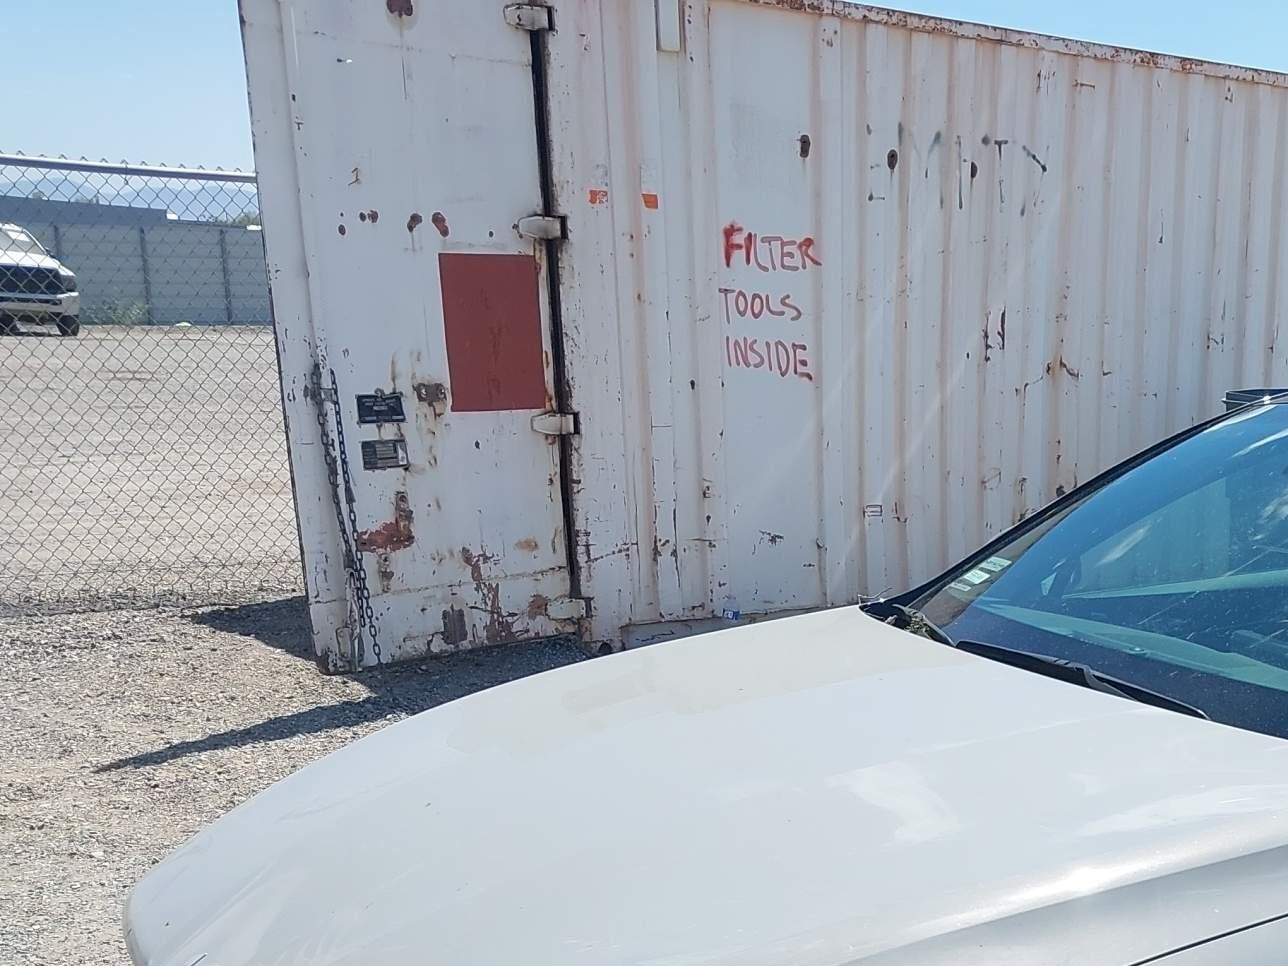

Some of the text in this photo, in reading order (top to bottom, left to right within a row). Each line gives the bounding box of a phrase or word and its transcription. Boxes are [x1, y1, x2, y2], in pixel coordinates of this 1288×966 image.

[722, 223, 823, 273] FILTER
[718, 287, 802, 325] TOOLS
[725, 335, 813, 381] INSIDE
